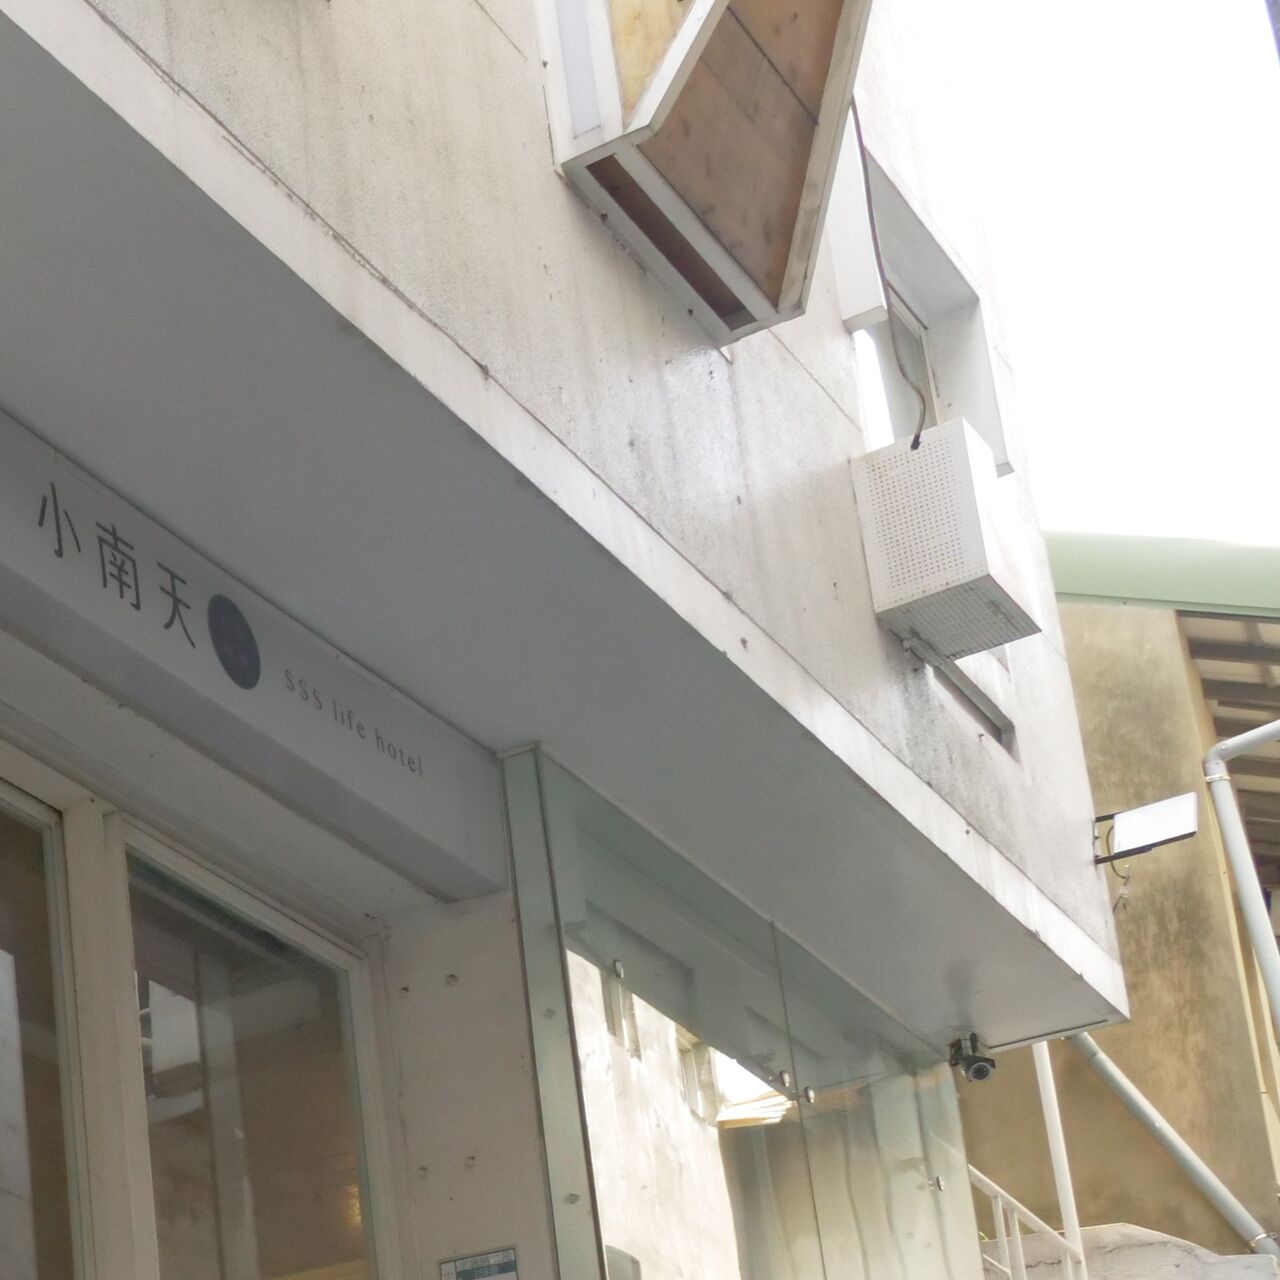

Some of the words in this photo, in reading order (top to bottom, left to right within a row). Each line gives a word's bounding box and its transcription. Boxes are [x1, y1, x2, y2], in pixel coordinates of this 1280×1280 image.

[38, 482, 196, 649] 小南天
[332, 698, 366, 741] life
[374, 728, 424, 777] hotel
